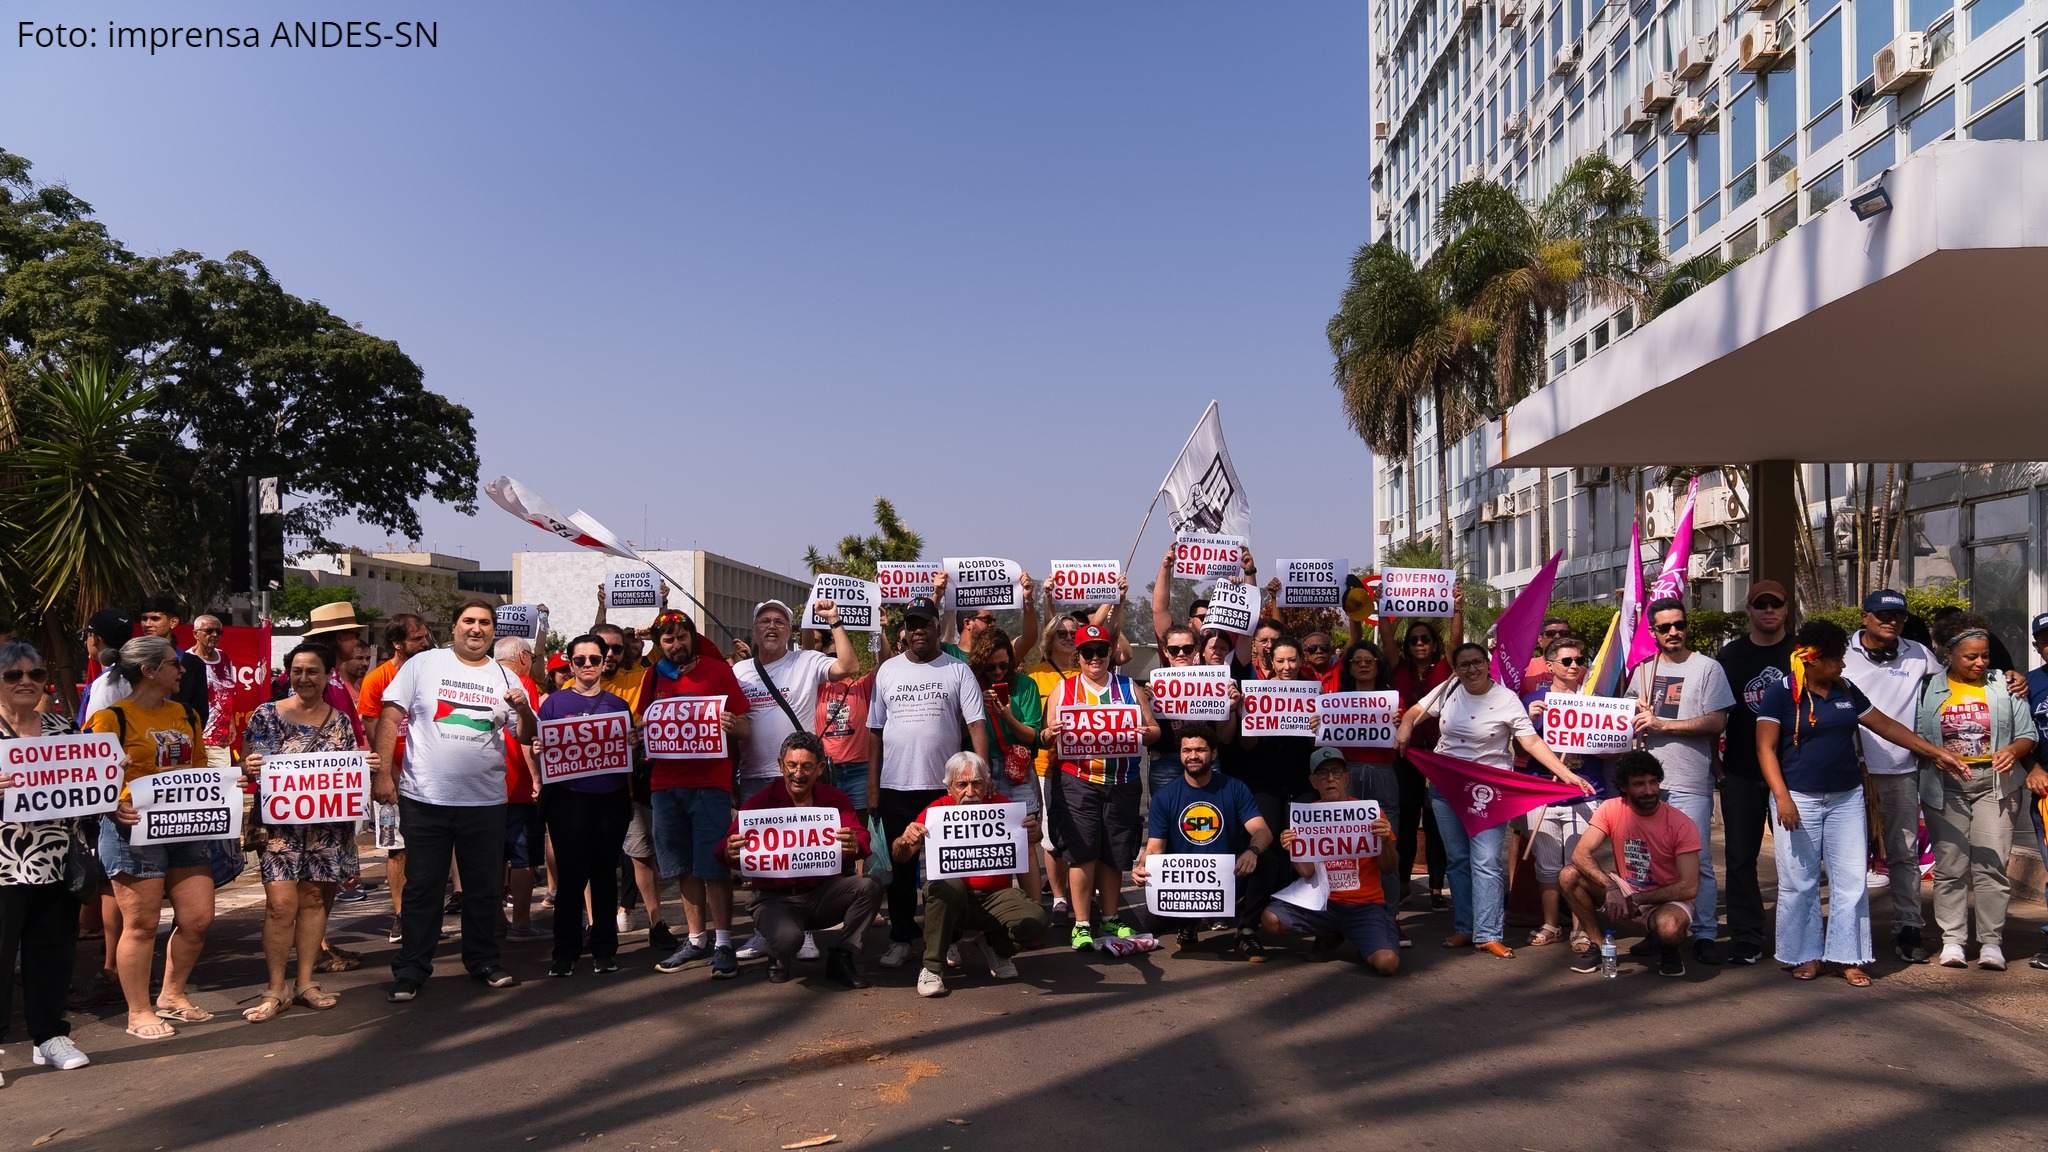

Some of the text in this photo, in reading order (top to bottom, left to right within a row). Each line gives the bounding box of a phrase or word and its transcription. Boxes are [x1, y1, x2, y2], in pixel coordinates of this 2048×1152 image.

[1178, 545, 1238, 562] 60 DIAS
[959, 560, 1005, 569] ACORDOS
[1176, 562, 1206, 575] SEM
[1290, 562, 1333, 570] ACORDOS
[818, 578, 864, 588] ACORDOS
[881, 570, 903, 585] 60
[959, 569, 1010, 583] FEITOS,
[1055, 570, 1116, 586] 60 DIAS
[1289, 572, 1337, 585] FEITOS,
[1386, 573, 1448, 586] GOVERNO,
[615, 579, 653, 589] FEITOS,
[1217, 582, 1247, 594] ORDOS
[817, 588, 869, 604] FEITOS,
[881, 587, 909, 598] SEM
[958, 587, 1011, 597] PROMESSAS
[1055, 588, 1084, 600] SEM
[1288, 588, 1337, 596] PROMESSAS
[1385, 587, 1448, 598] CUMPRA O
[958, 595, 1012, 605] QUEBRADAS!
[1212, 591, 1249, 609] EITOS,
[1385, 600, 1448, 612] ACORDO
[498, 612, 528, 624] EITOS,
[1207, 606, 1248, 620] OMESSAS
[438, 688, 457, 700] POVO
[896, 682, 943, 692] SINASEFE
[1154, 680, 1226, 698] 60 DIAS
[918, 692, 948, 701] LUTAR
[1322, 697, 1392, 710] GOVERNO,
[648, 702, 718, 720] BASTA
[1153, 700, 1226, 714] SEM ACORDO
[1245, 695, 1316, 714] 60 DIAS
[1548, 699, 1584, 707] ESTAMOS
[1599, 702, 1618, 710] MAIS
[1062, 711, 1134, 730] BASTA
[1245, 716, 1279, 730] SEM
[1322, 714, 1390, 724] CUMPRA O
[1547, 708, 1628, 731] 60 DIAS
[544, 720, 624, 746] BASTA
[699, 724, 718, 737] DE
[1116, 731, 1136, 742] DE
[1322, 727, 1391, 741] ACORDO
[1547, 730, 1628, 746] SEM ACORDO
[9, 742, 118, 764] GOVERNO,
[604, 740, 624, 754] DE
[10, 765, 118, 788] CUMPRA O
[152, 772, 221, 786] ACORDOS
[269, 768, 362, 792] TAMBÉM
[14, 784, 118, 813] ACORDO
[153, 786, 225, 804] FEITOS,
[270, 792, 364, 820] COME
[150, 810, 228, 824] PROMESSAS
[743, 816, 784, 826] ESTAMOS
[786, 814, 798, 823] HÁ
[800, 814, 820, 822] MAIS
[944, 809, 1006, 822] ACORDOS
[1292, 807, 1377, 824] QUEREMOS
[150, 822, 228, 837] QUEBRADAS!
[944, 822, 1012, 840] FEITOS,
[1292, 824, 1371, 835] APOSENTADORI
[744, 827, 836, 852] 60 DIAS
[1292, 836, 1378, 857] DIGNA!
[942, 846, 1012, 860] PROMESSAS
[744, 851, 836, 872] SEM ACORDO
[792, 861, 836, 870] CUMPRIDO
[942, 857, 1013, 872] QUEBRADAS!
[1162, 858, 1216, 868] ACORDOS
[1162, 870, 1221, 887] FEITOS,
[1160, 892, 1222, 900] PROMESSAS
[1160, 901, 1222, 910] QUEBRADAS!
